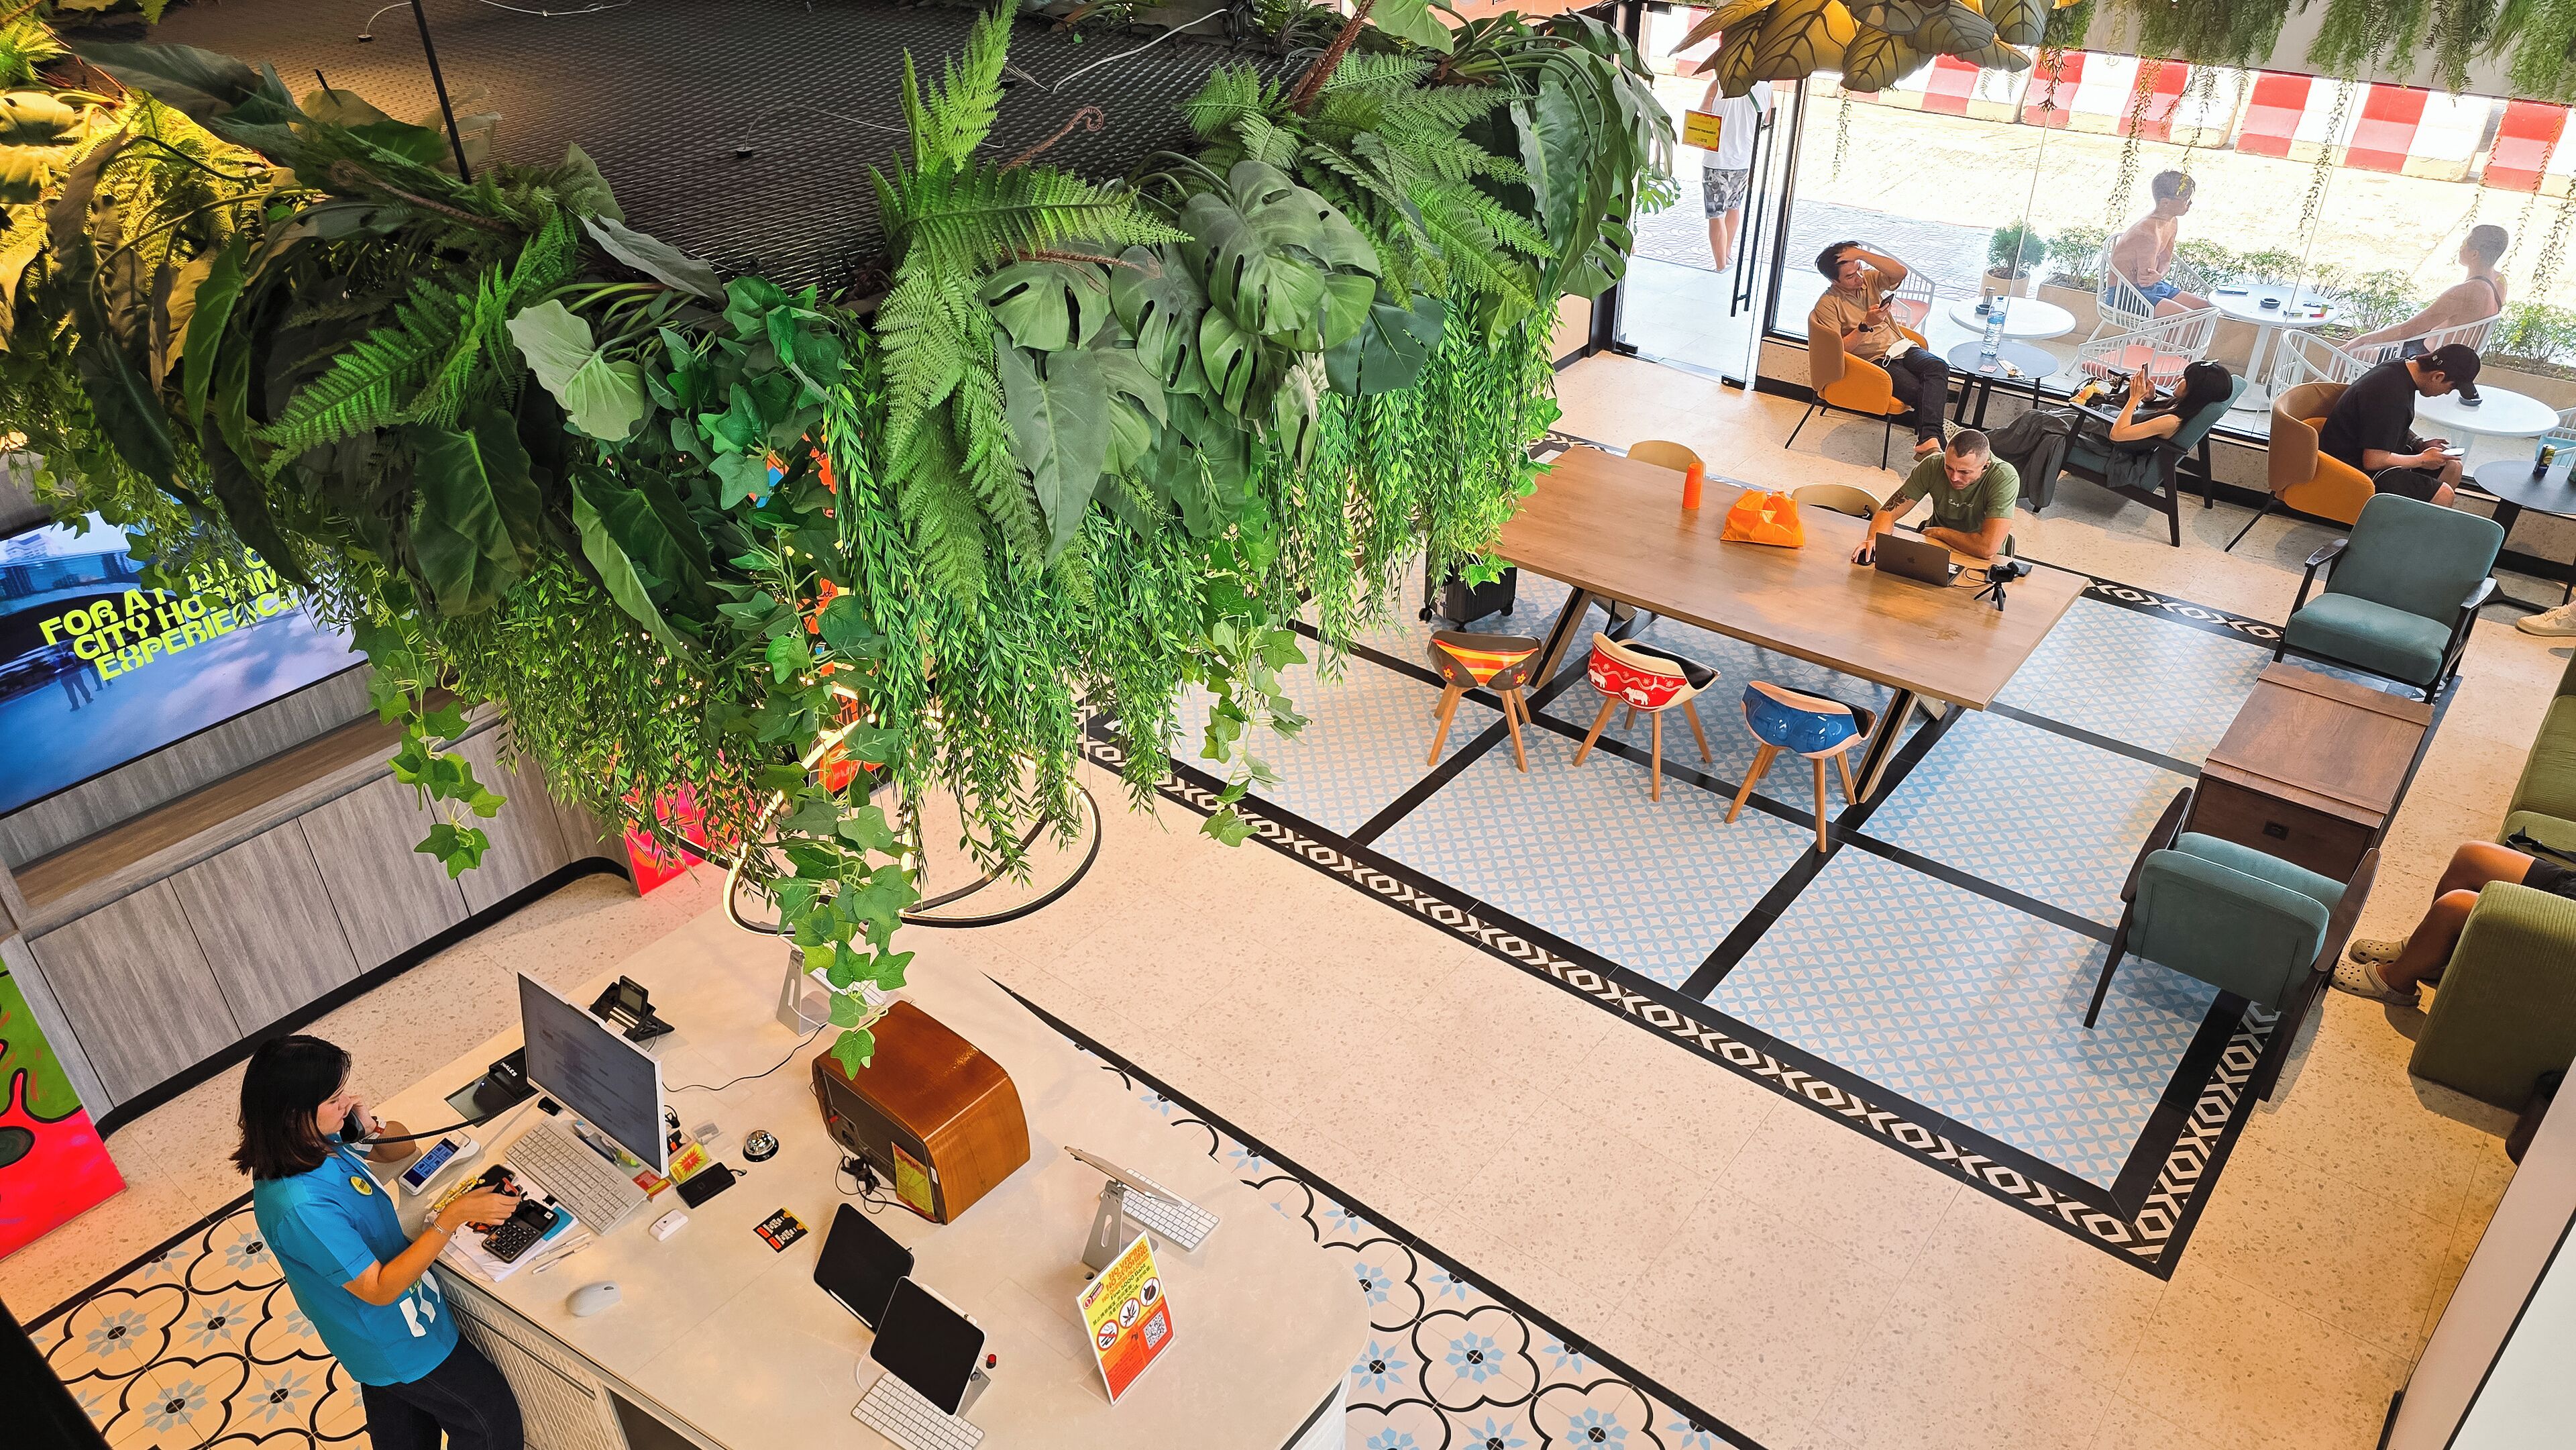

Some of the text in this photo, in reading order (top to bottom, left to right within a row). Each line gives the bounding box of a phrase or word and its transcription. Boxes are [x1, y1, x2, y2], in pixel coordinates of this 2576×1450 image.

[39, 588, 152, 646] FOR A
[74, 613, 150, 660] CITY
[1109, 1267, 1118, 1280] NO
[1120, 1241, 1144, 1268] VAPING
[1106, 1278, 1116, 1291] NO
